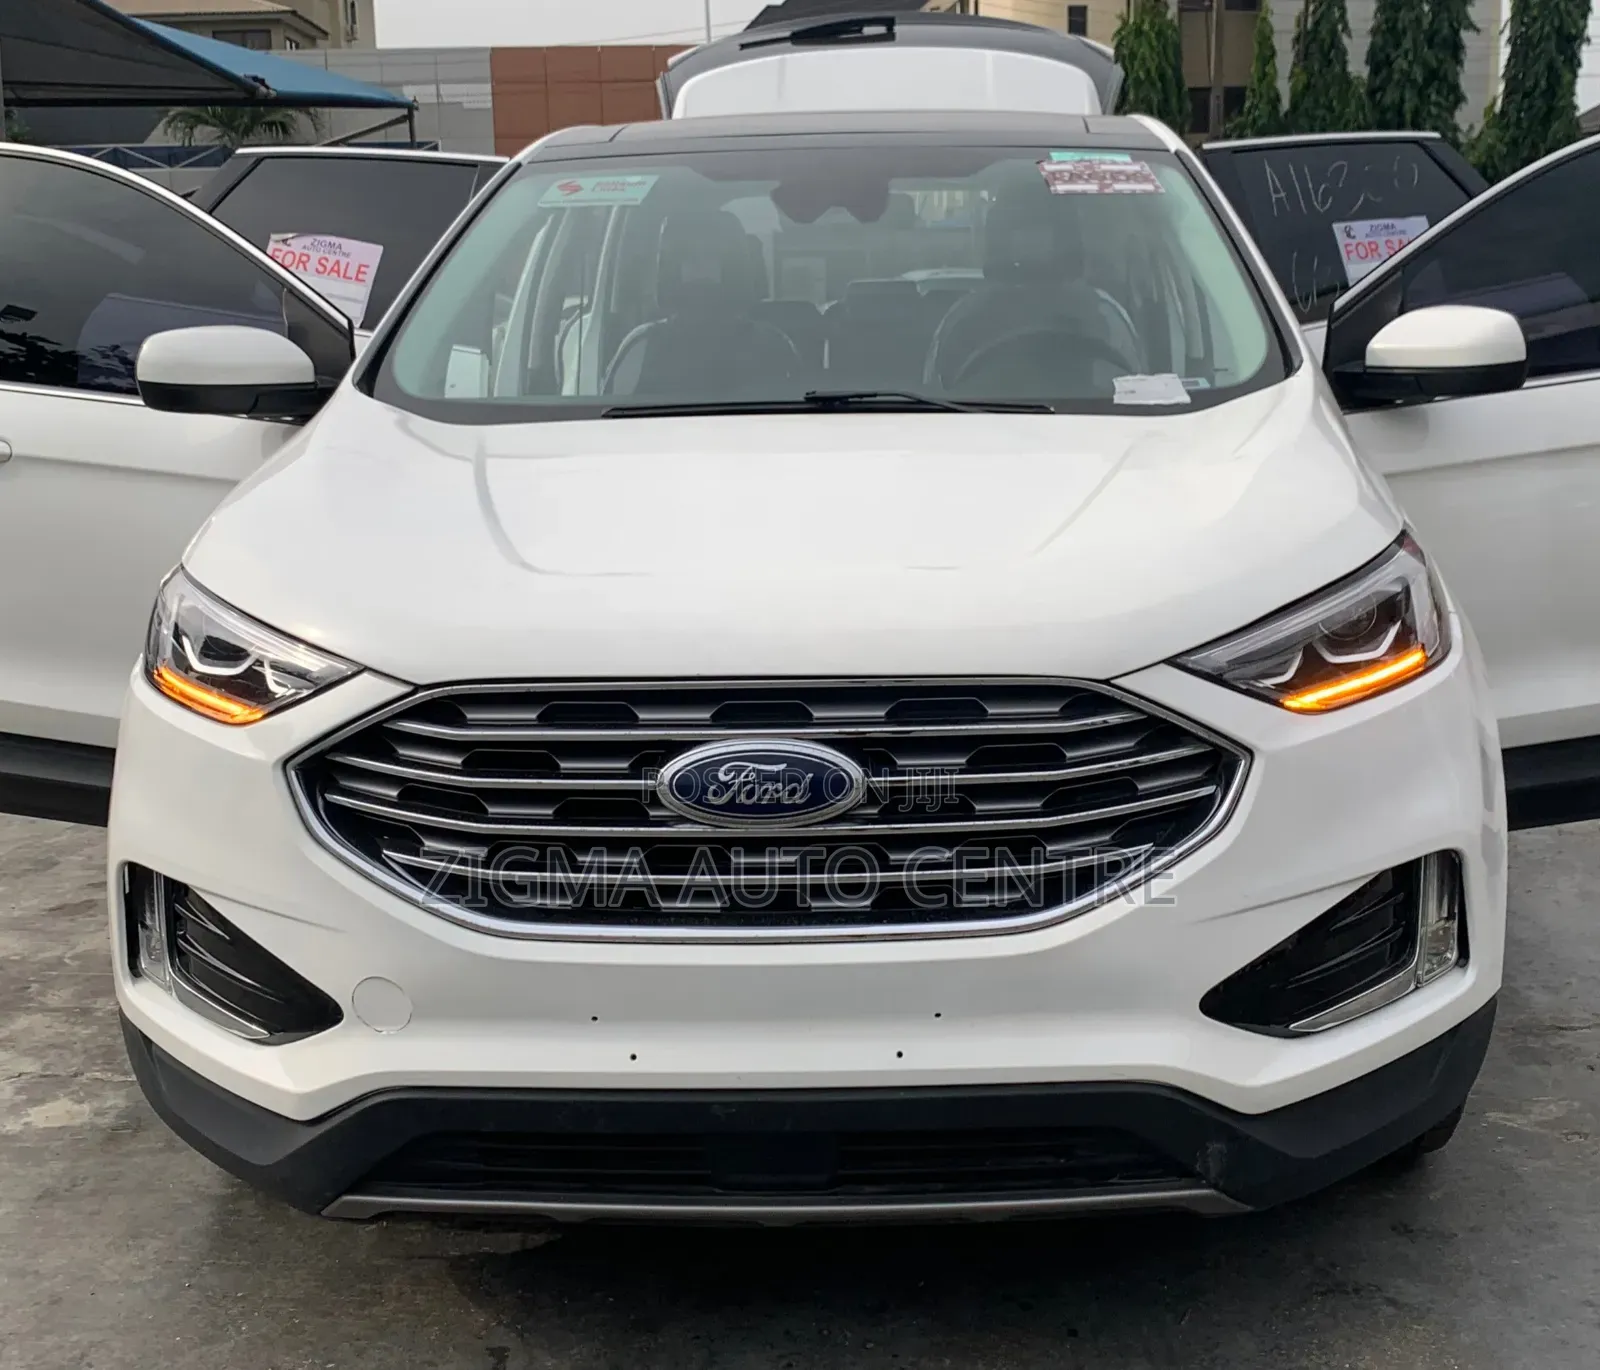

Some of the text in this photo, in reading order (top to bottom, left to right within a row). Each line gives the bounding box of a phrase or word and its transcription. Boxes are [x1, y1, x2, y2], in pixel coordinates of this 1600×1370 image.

[301, 245, 352, 258] AUTO CENTRE
[310, 238, 343, 250] ZIGMA
[1344, 240, 1382, 261] FOR
[270, 248, 370, 283] FOR SALE
[706, 761, 814, 806] Ford
